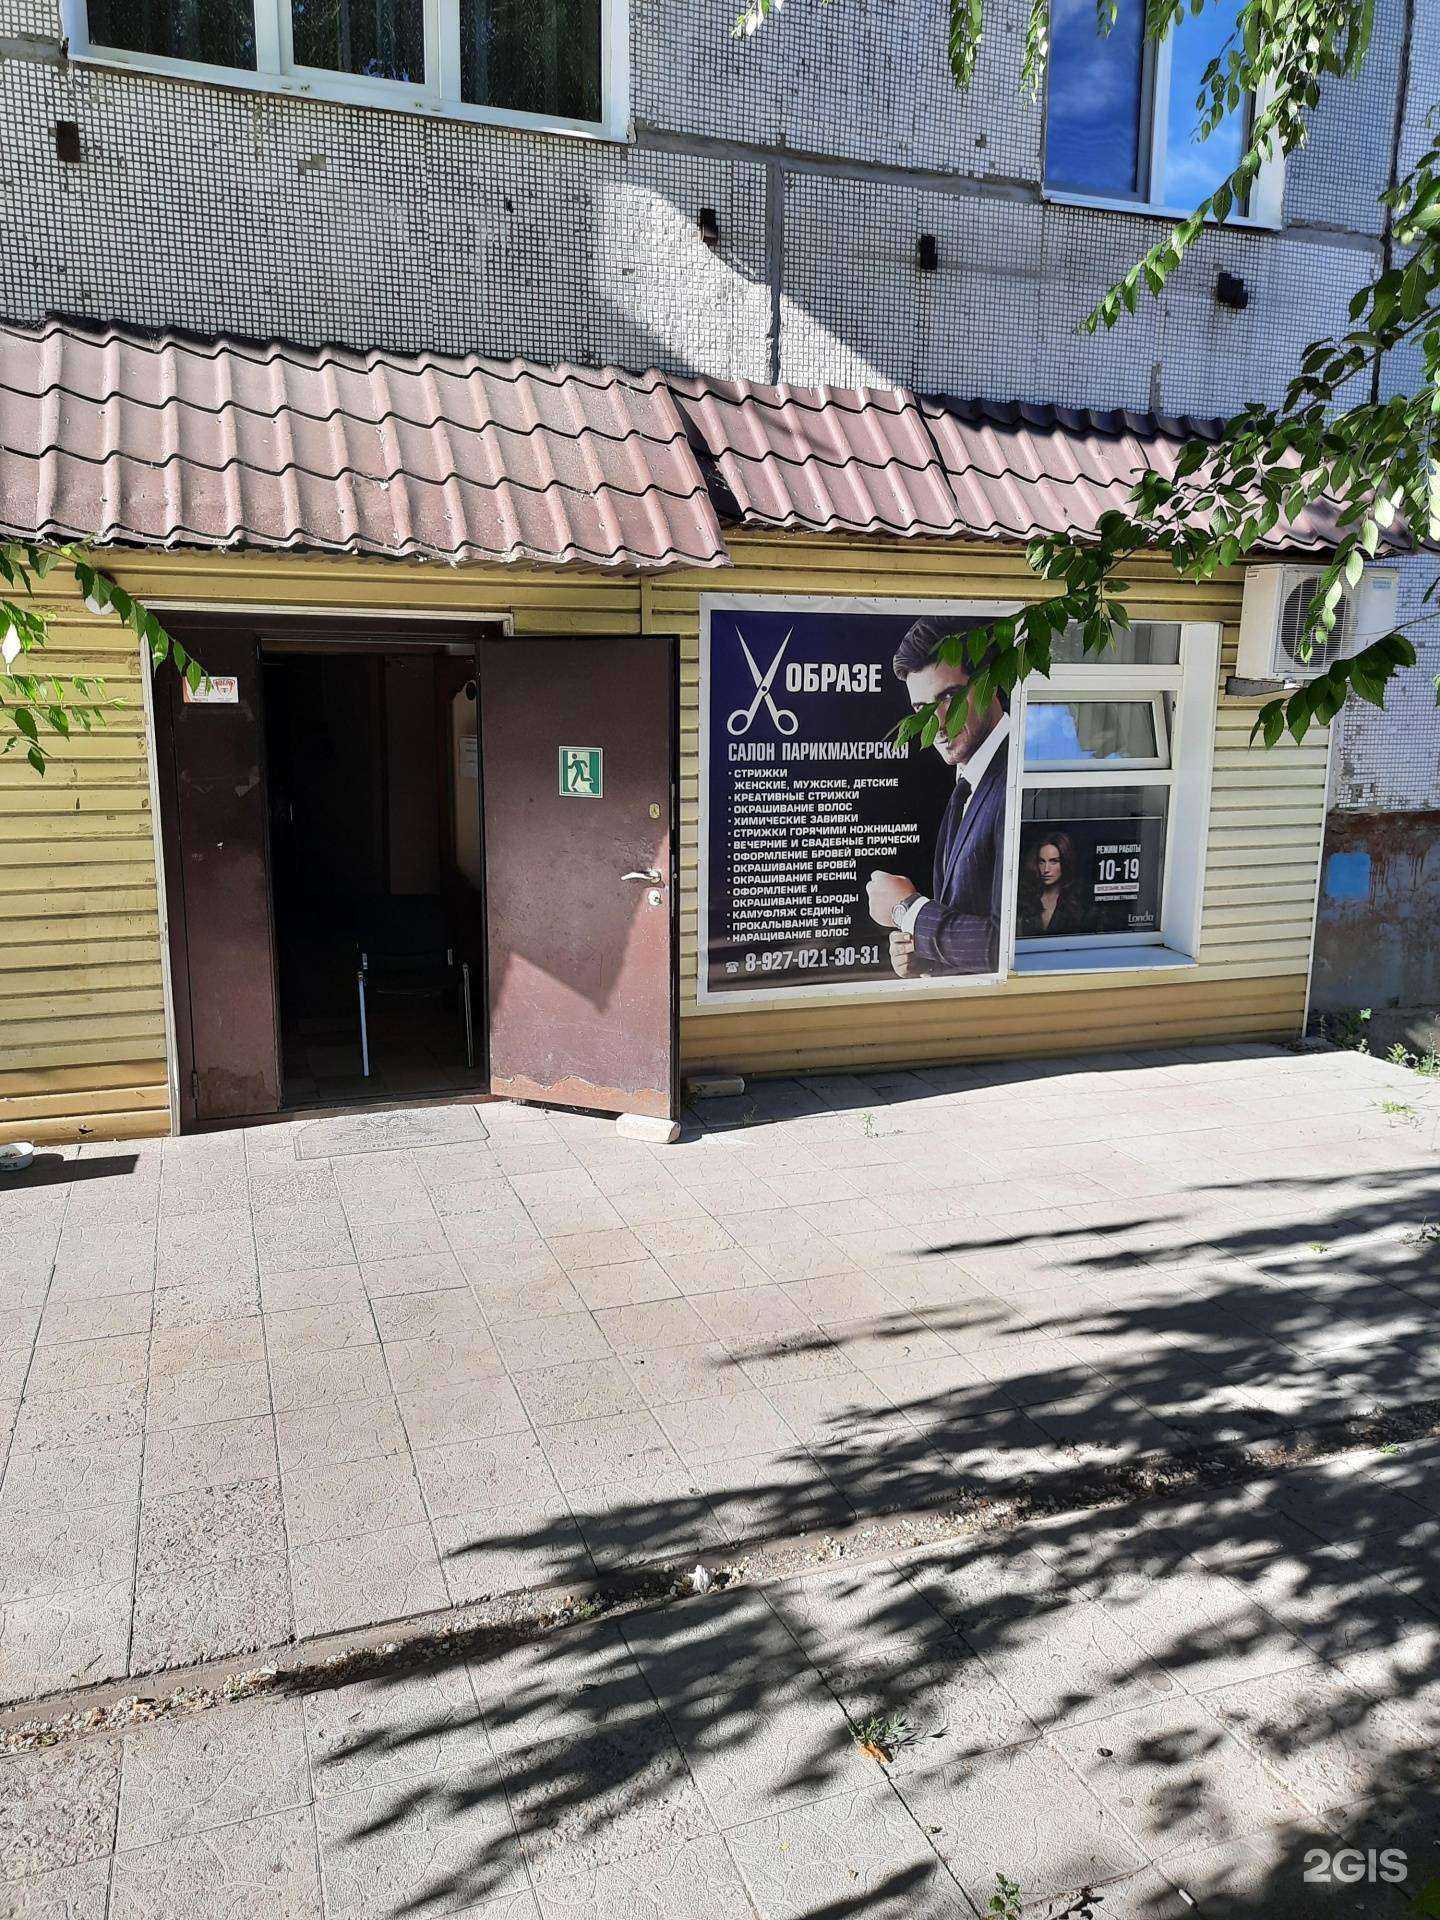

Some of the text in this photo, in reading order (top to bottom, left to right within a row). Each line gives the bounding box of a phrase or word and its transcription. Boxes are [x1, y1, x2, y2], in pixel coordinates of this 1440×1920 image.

[785, 663, 882, 693] ОБРАЗЕ
[728, 741, 909, 761] САЛОН ПАРИКМАХЕРСКАЯ
[734, 769, 788, 778] СТРИЖКИ
[734, 778, 899, 790] ЖЕНСКИЕ, МУЖСКИЕ, ДЕТСКИЕ
[734, 791, 860, 802] КРЕАТИВНЫЕ СТРИЖКИ
[733, 802, 853, 814] ОКРАШИВАНИЕ ВОЛОС
[733, 814, 859, 826] ХИМИЧЕСКИЕ ЗАВИВКИ
[733, 823, 918, 838] СТРИЖКИ ГОРЯЧИМИ НОЖНИЦАМИ
[733, 835, 920, 850] ВЕЧЕРНИЕ И СВАДЕБНЫЕ ПРИЧЕСКИ
[1118, 844, 1141, 853] РАБОТЫ
[733, 847, 897, 861] ОФОРМЛЕНИЕ БРОВЕЙ ВОСКОМ
[733, 858, 857, 873] ОКРАШИВАНИЕ БРОВЕЙ
[1098, 858, 1139, 881] 10-19
[733, 871, 857, 885] ОКРАШИВАНИЕ РЕСНИЦ
[732, 884, 819, 896] ОФОРМЛЕНИЕ И
[732, 894, 859, 908] ОКРАШИВАНИЕ БОРОДЫ
[732, 906, 844, 919] КАМУФЛЯЖ СЕДИНЫ
[732, 915, 852, 931] ПРОКАЛЫВАНИЕ УШЕЙ
[732, 928, 850, 942] НАРАЩИВАНИЕ ВОЛОС
[745, 945, 880, 972] 8-927-021-30-31
